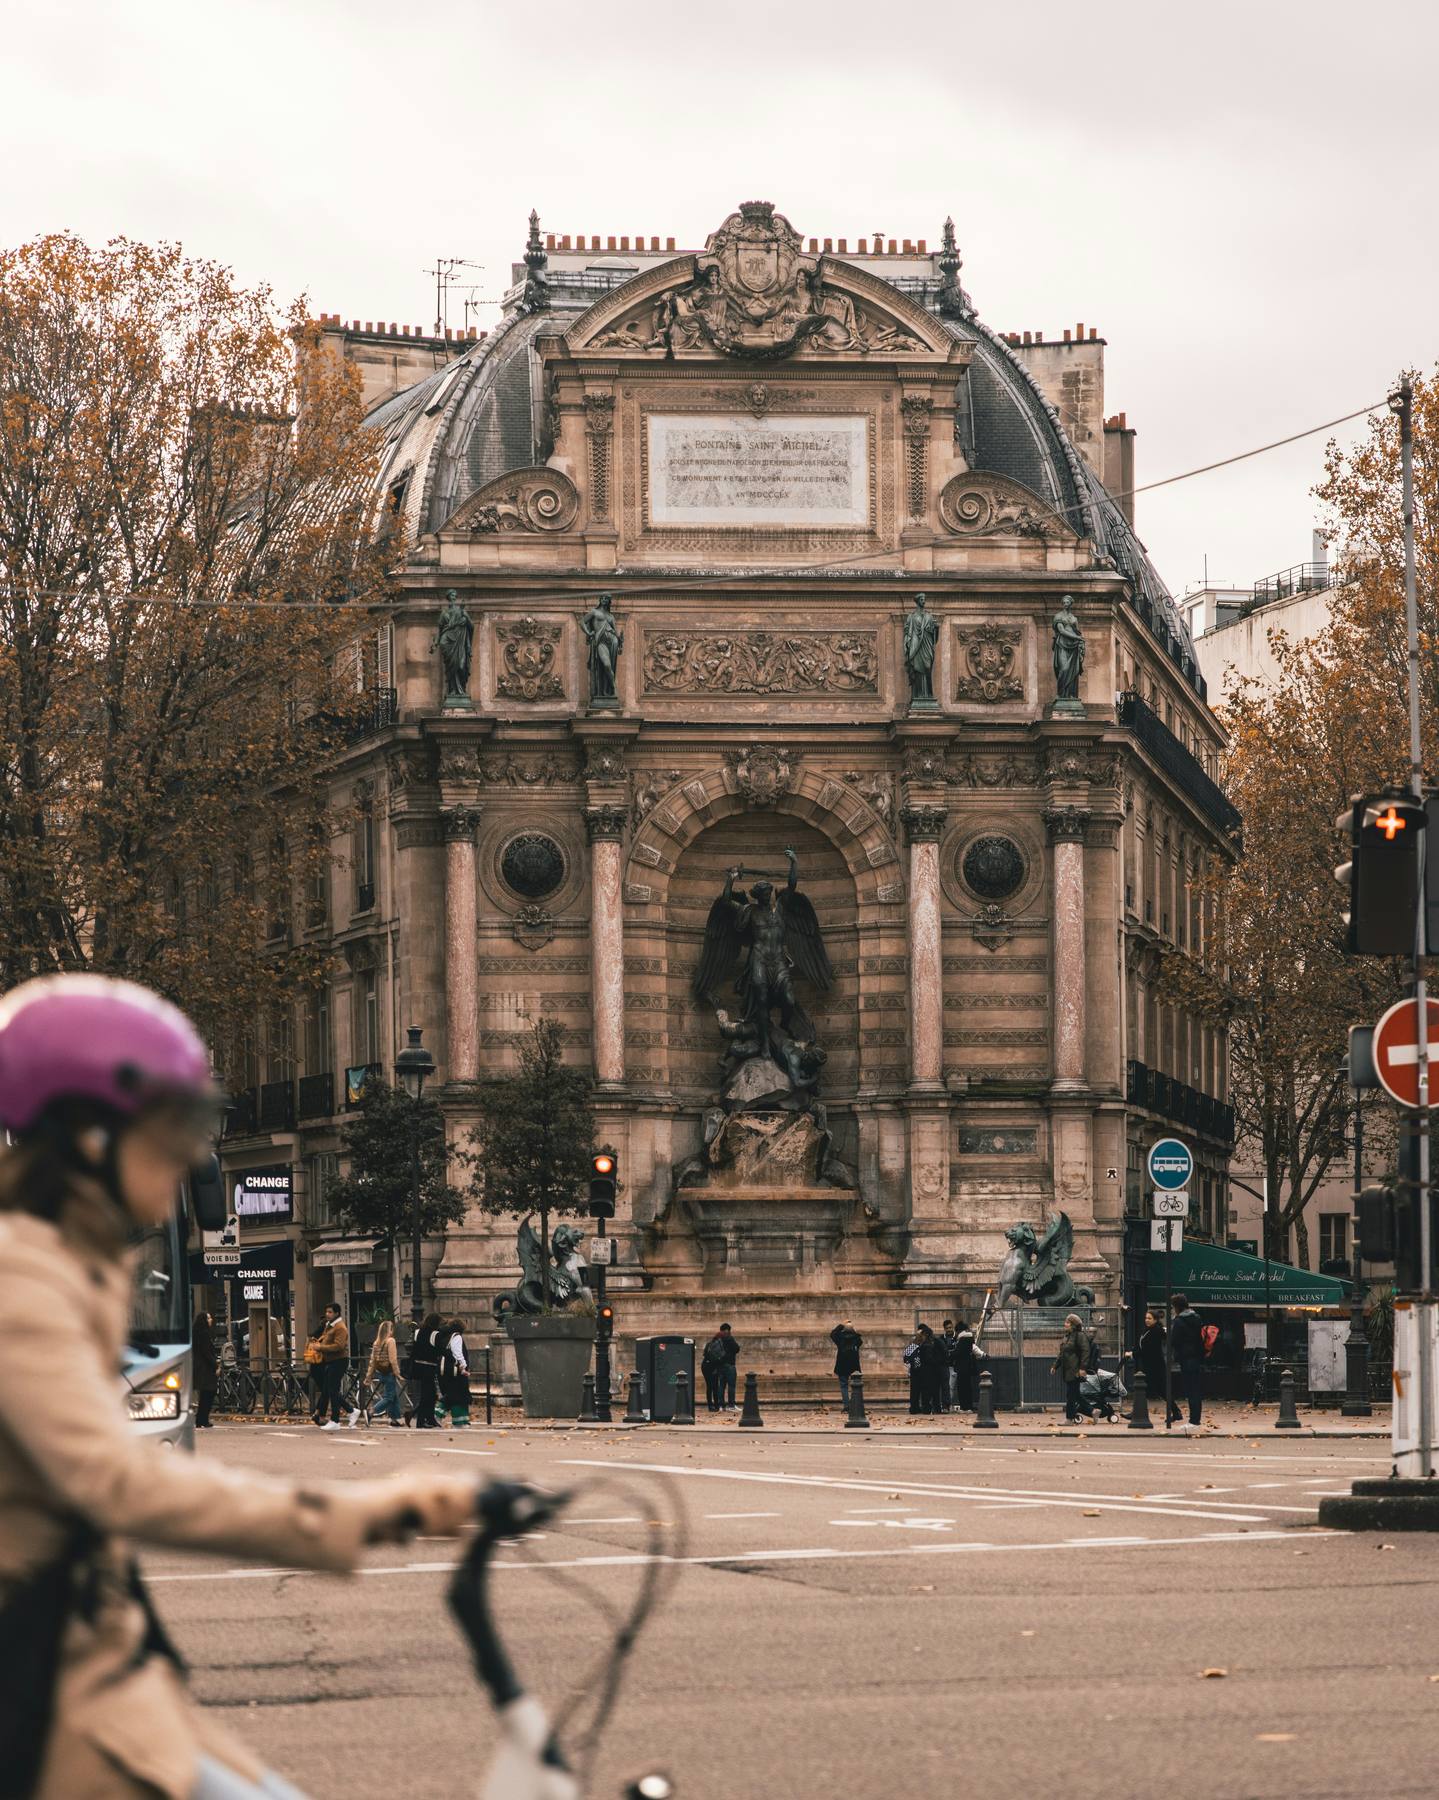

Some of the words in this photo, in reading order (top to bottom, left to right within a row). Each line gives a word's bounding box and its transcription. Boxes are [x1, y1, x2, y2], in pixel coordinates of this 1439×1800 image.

[749, 441, 775, 450] SAINT
[782, 441, 820, 451] MICHEL
[246, 1177, 289, 1188] CHANGE
[237, 1270, 277, 1278] CHANGE
[1258, 1270, 1287, 1282] Mchel
[243, 1285, 264, 1300] CHANGE
